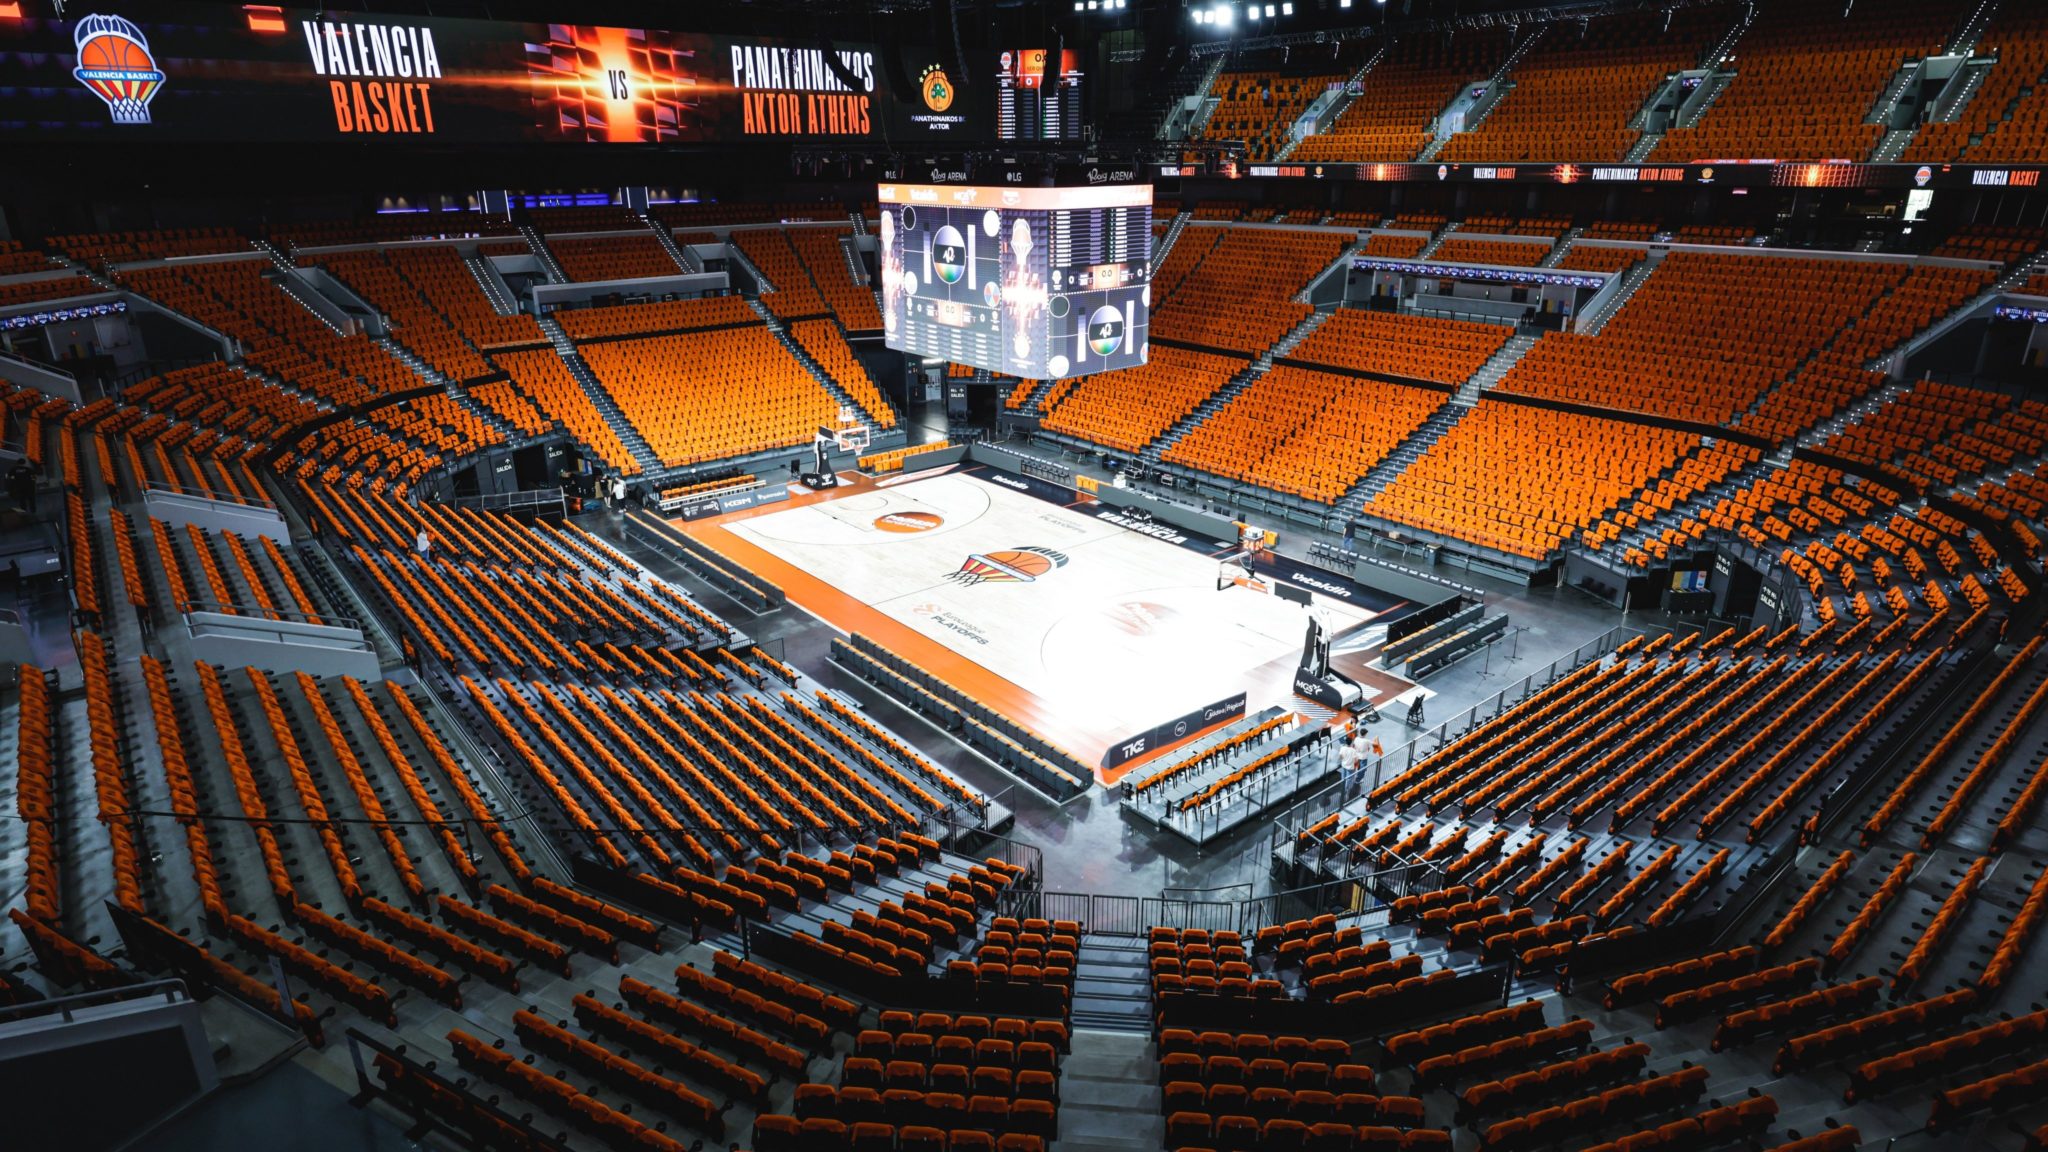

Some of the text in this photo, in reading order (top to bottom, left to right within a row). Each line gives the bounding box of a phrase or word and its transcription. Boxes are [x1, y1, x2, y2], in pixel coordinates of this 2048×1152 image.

[302, 20, 442, 78] VALENCIA
[82, 71, 159, 80] VALENCIA BASKET
[608, 69, 628, 100] VS
[330, 80, 435, 133] BASKET
[743, 92, 871, 134] AKTOR ATHENS
[911, 115, 958, 123] PANATHINAIKOS
[947, 172, 967, 181] ARENA
[1012, 172, 1022, 181] LG
[1109, 171, 1134, 181] ARENA
[1473, 167, 1516, 179] VALENCIA BASKET
[1592, 167, 1638, 180] PANATHINAIKOS
[1638, 168, 1659, 180] AKTOR
[1659, 168, 1684, 181] ATHENS
[1972, 170, 2040, 186] VALENCIA BASKET
[496, 464, 512, 473] SALIDA
[723, 497, 752, 509] KGM
[1097, 511, 1188, 544] VALENCIA
[1716, 562, 1729, 576] SALIDA
[1291, 572, 1352, 597] Vitaldin
[1760, 594, 1776, 609] SALIDA
[930, 615, 989, 645] PLAYOFFS
[1295, 679, 1313, 693] MGS
[1121, 738, 1145, 759] TKE
